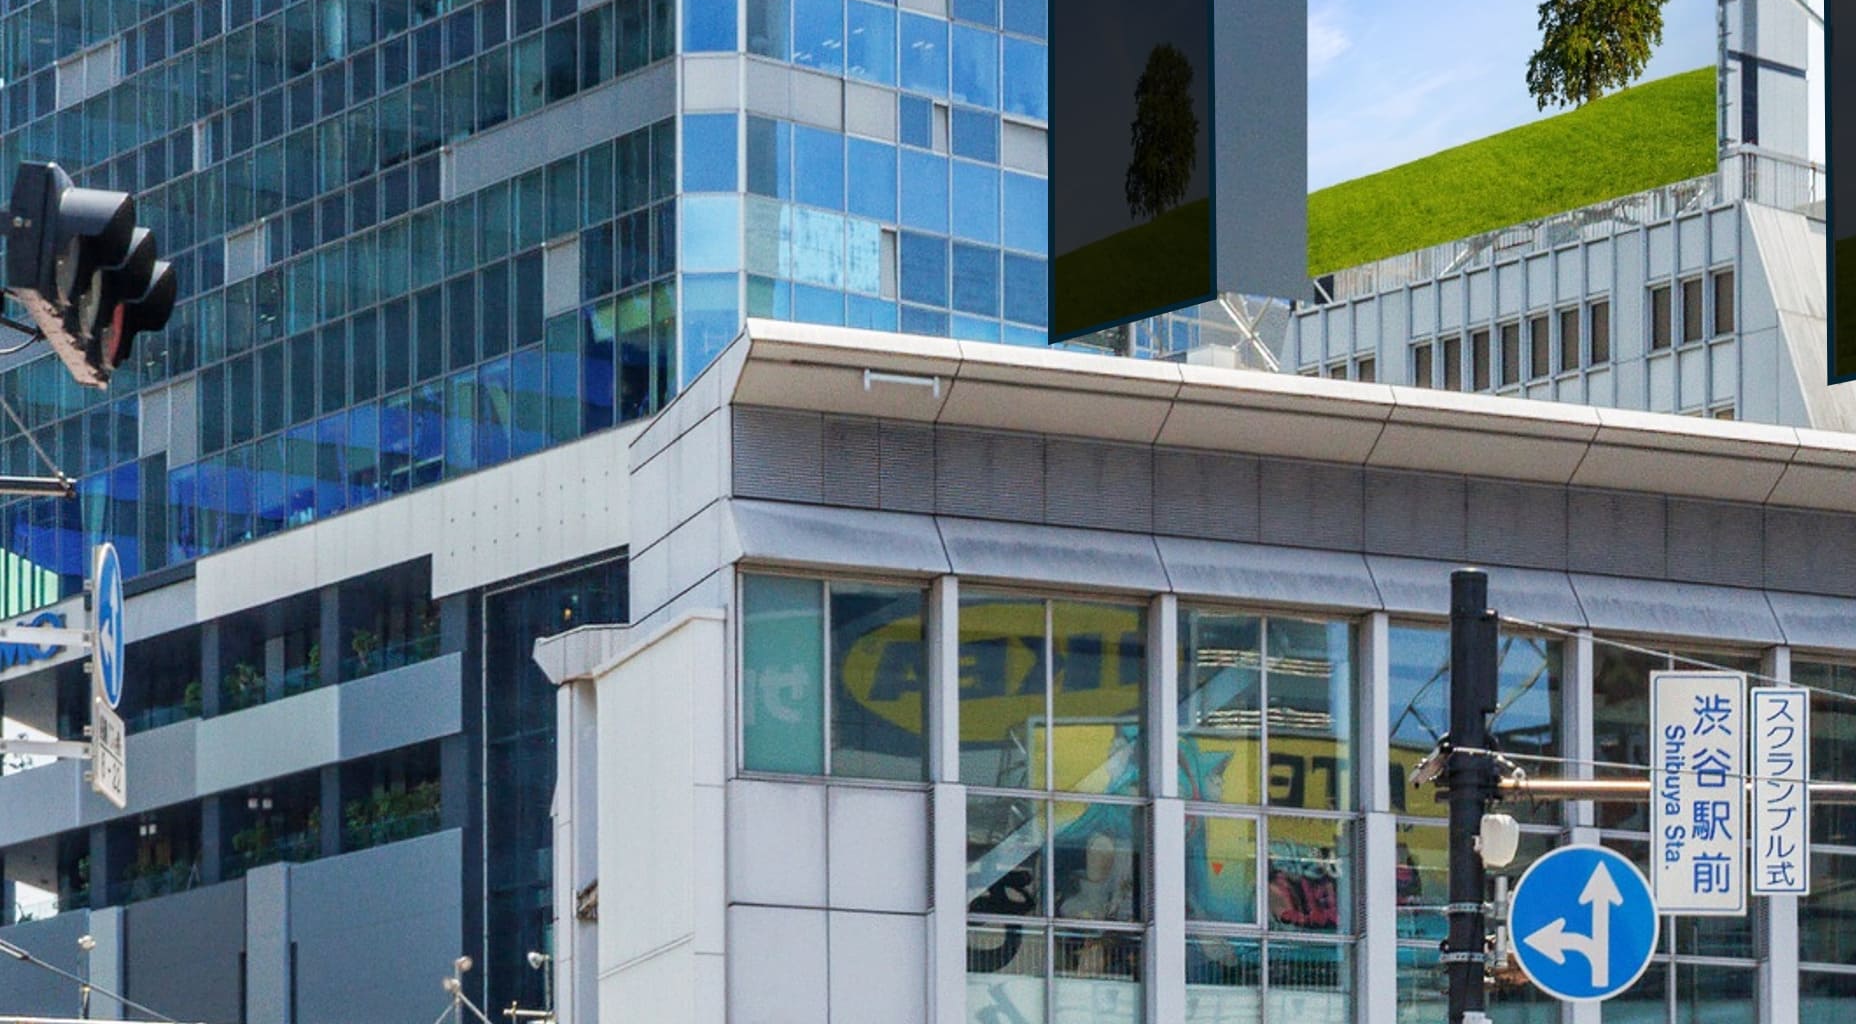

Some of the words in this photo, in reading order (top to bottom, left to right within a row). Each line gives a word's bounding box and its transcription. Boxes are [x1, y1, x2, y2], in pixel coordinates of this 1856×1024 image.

[1662, 725, 1685, 815] Shibuya
[1691, 694, 1732, 893] 渋谷駅前
[1766, 699, 1796, 886] スクランブル式
[1665, 826, 1685, 870] Sta.
